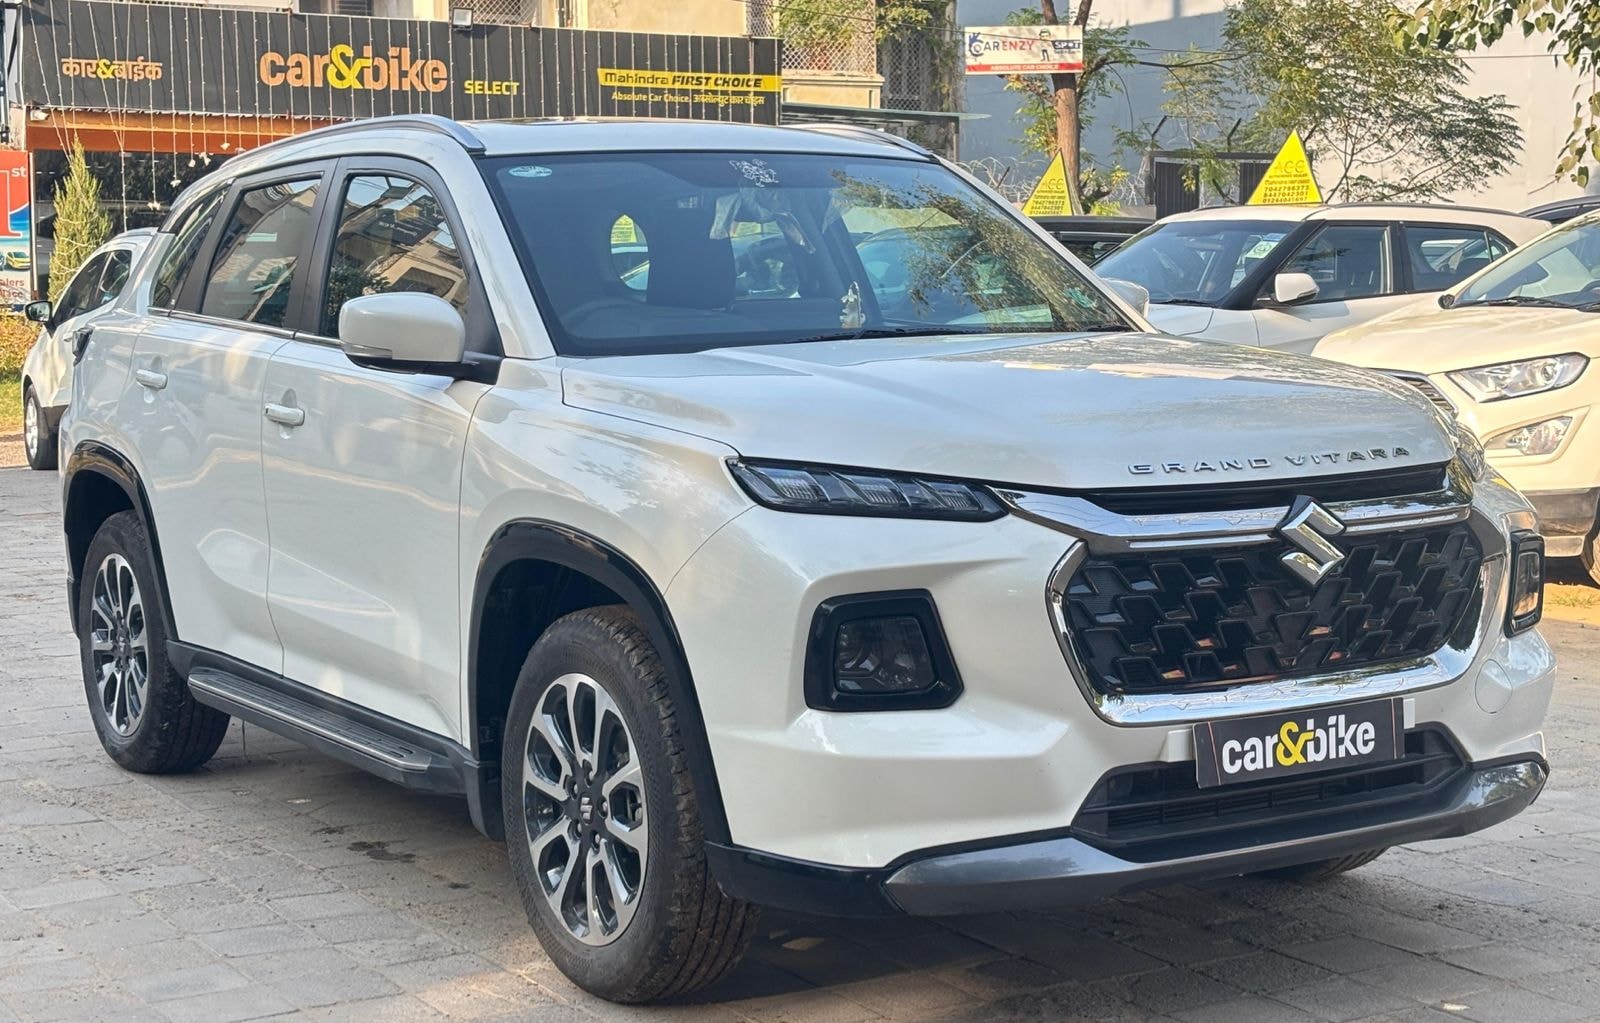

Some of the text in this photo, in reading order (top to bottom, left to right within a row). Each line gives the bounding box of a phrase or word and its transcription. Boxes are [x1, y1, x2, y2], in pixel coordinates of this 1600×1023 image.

[61, 56, 162, 82] कार&बाईक
[259, 44, 448, 92] car&bike
[604, 72, 763, 88] Mahindra FIRST CHOICE
[464, 80, 520, 96] SELECT
[611, 91, 648, 101] Absolute
[648, 93, 662, 102] Car
[1128, 447, 1410, 475] GRAND VITARA
[1222, 714, 1376, 774] car&bike
